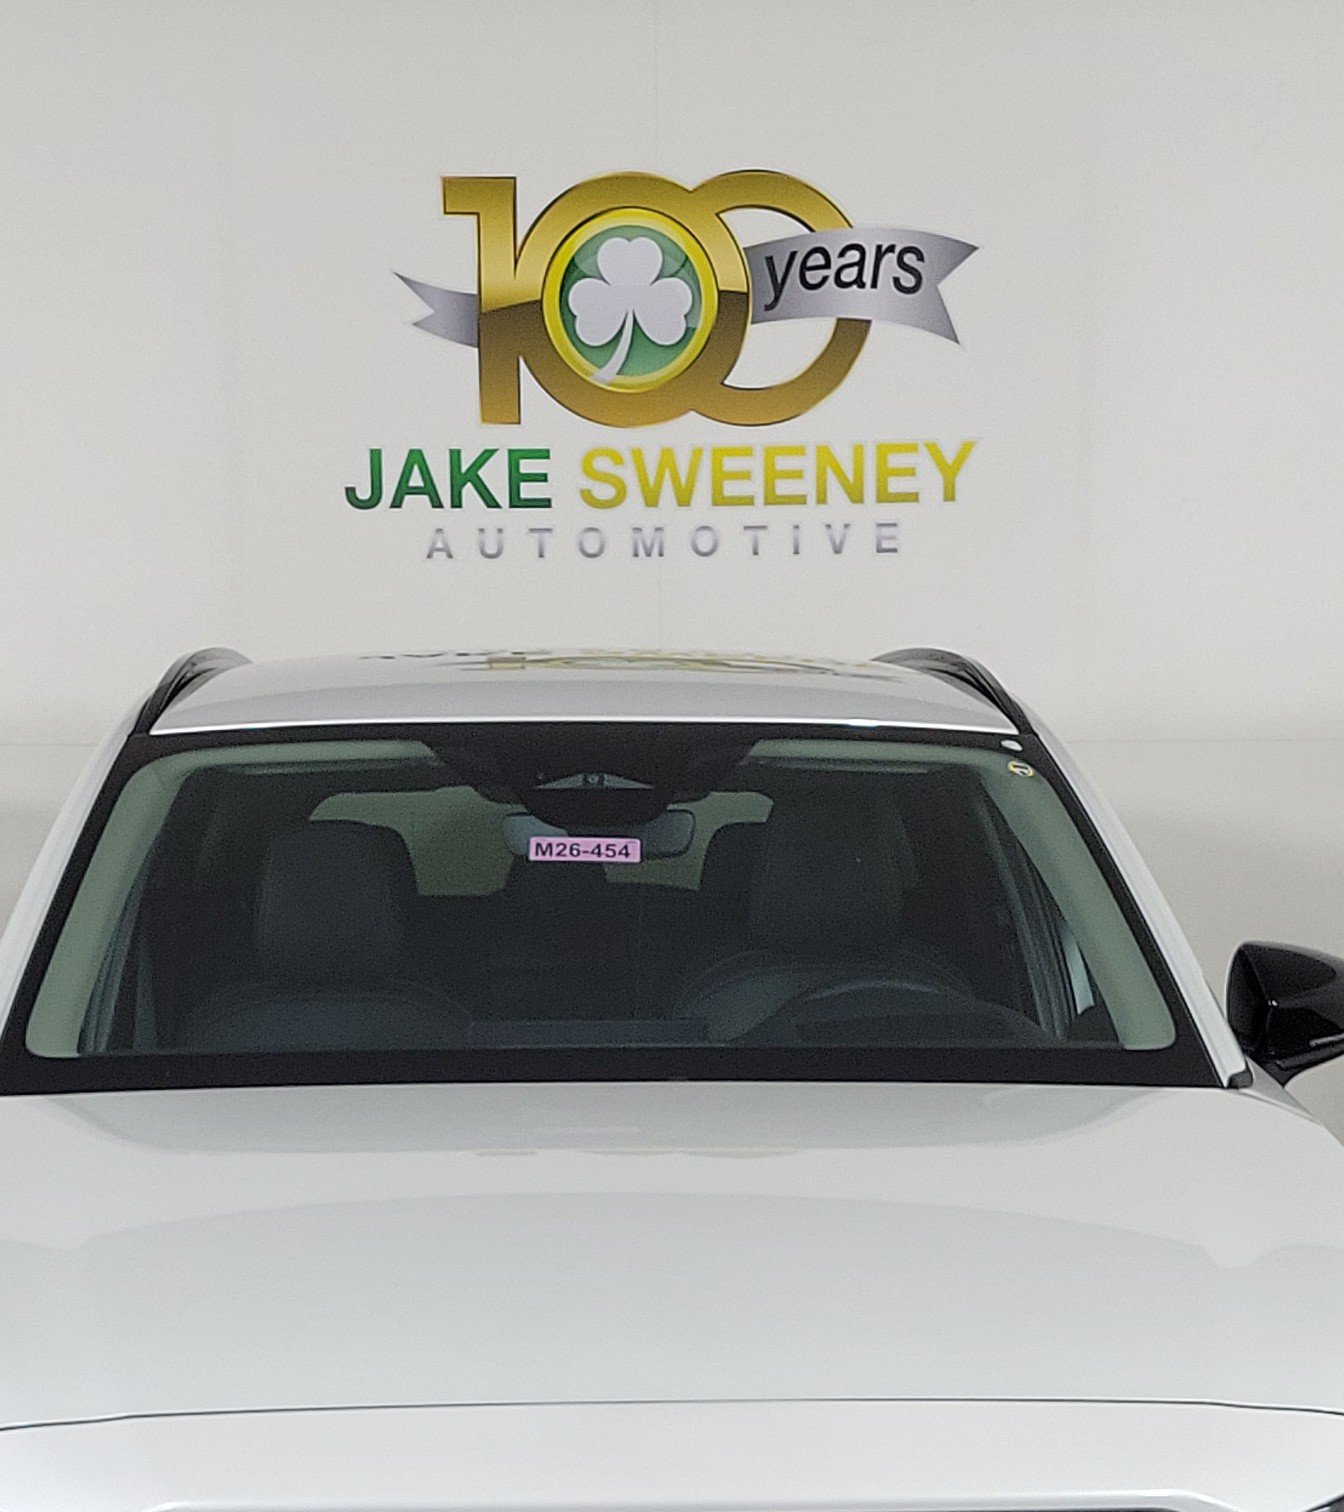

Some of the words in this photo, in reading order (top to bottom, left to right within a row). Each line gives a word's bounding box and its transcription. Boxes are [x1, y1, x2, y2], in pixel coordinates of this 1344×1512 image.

[441, 168, 872, 428] 100
[761, 238, 926, 312] years
[343, 446, 553, 510] JAKE
[578, 440, 977, 509] SWEENEY
[425, 521, 901, 560] AUTOMOTIVE
[534, 842, 631, 859] M26-454
